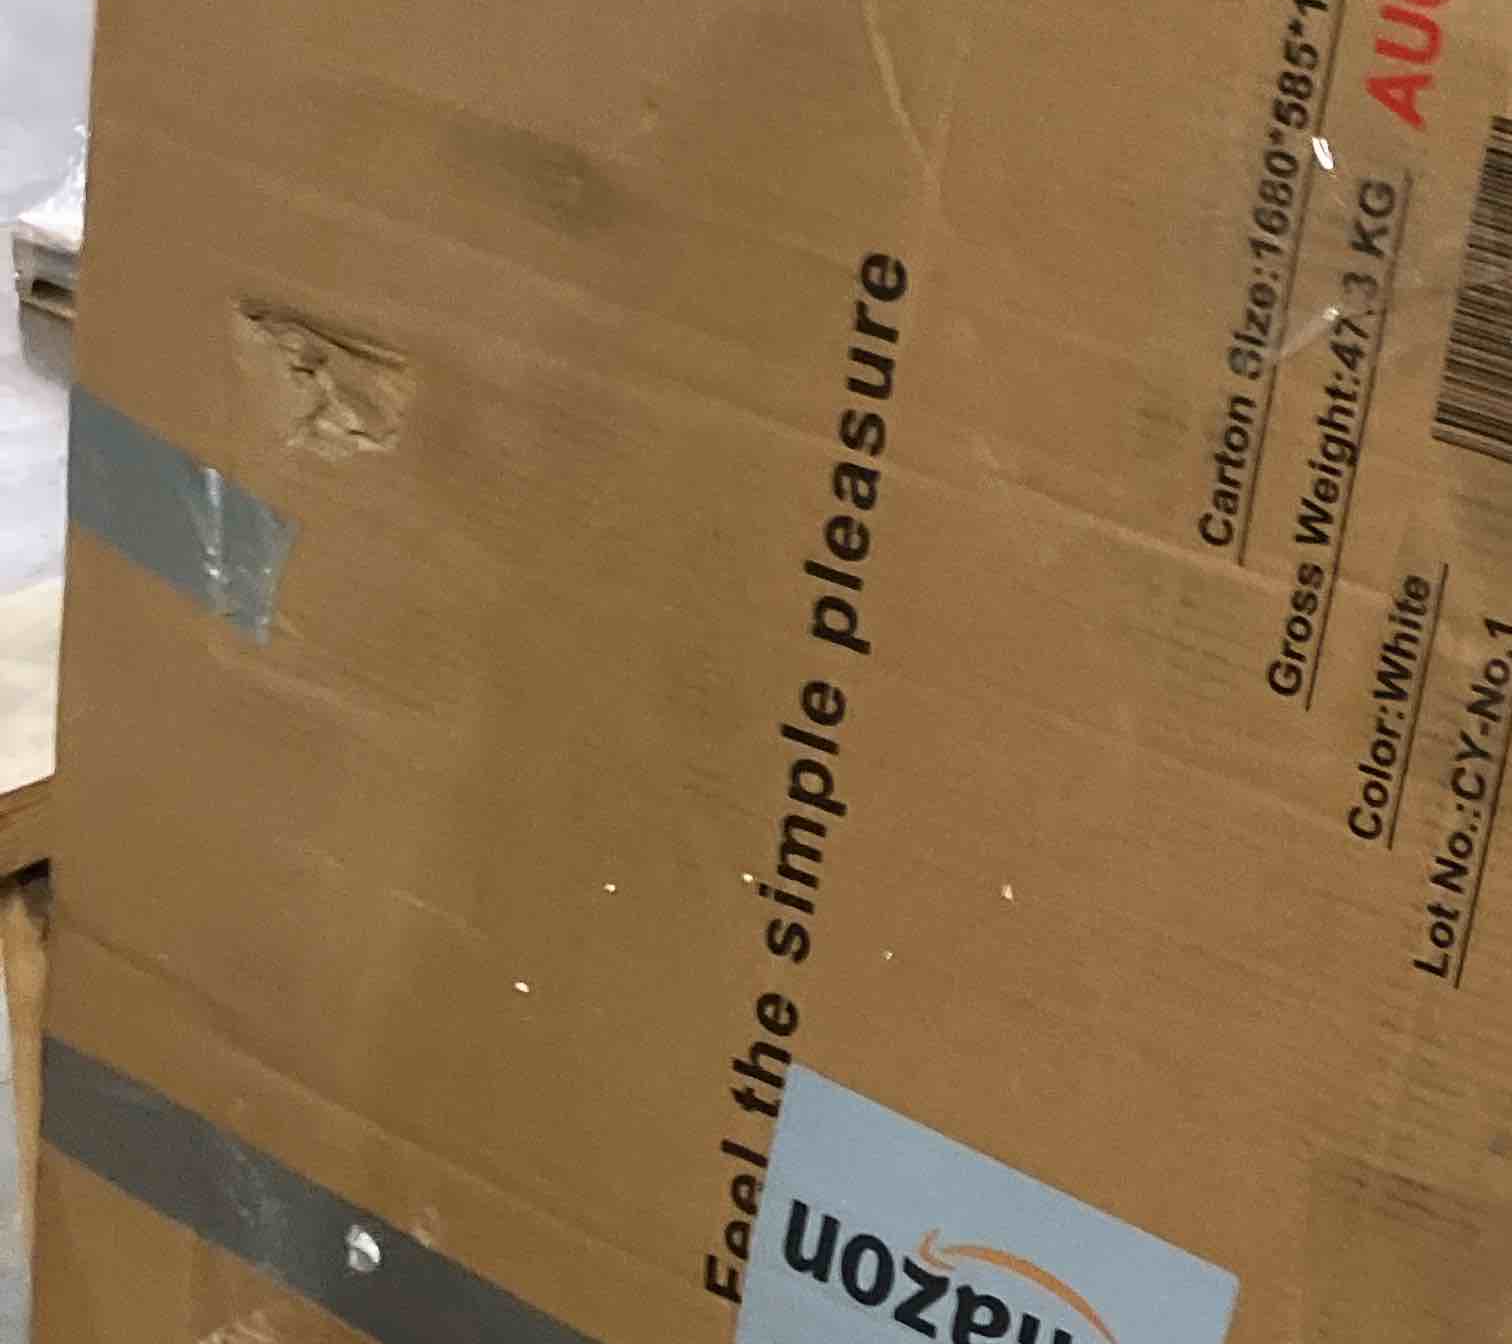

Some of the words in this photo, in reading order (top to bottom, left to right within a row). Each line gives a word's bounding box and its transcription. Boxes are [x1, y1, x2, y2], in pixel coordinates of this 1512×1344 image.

[807, 251, 909, 656] pleasure
[1199, 391, 1257, 548] Carton
[1269, 561, 1325, 697] Gross
[1353, 179, 1398, 259] KG
[756, 677, 848, 966] simple
[1348, 574, 1432, 842] Color:White
[731, 993, 800, 1124] the
[1415, 905, 1459, 980] Lot
